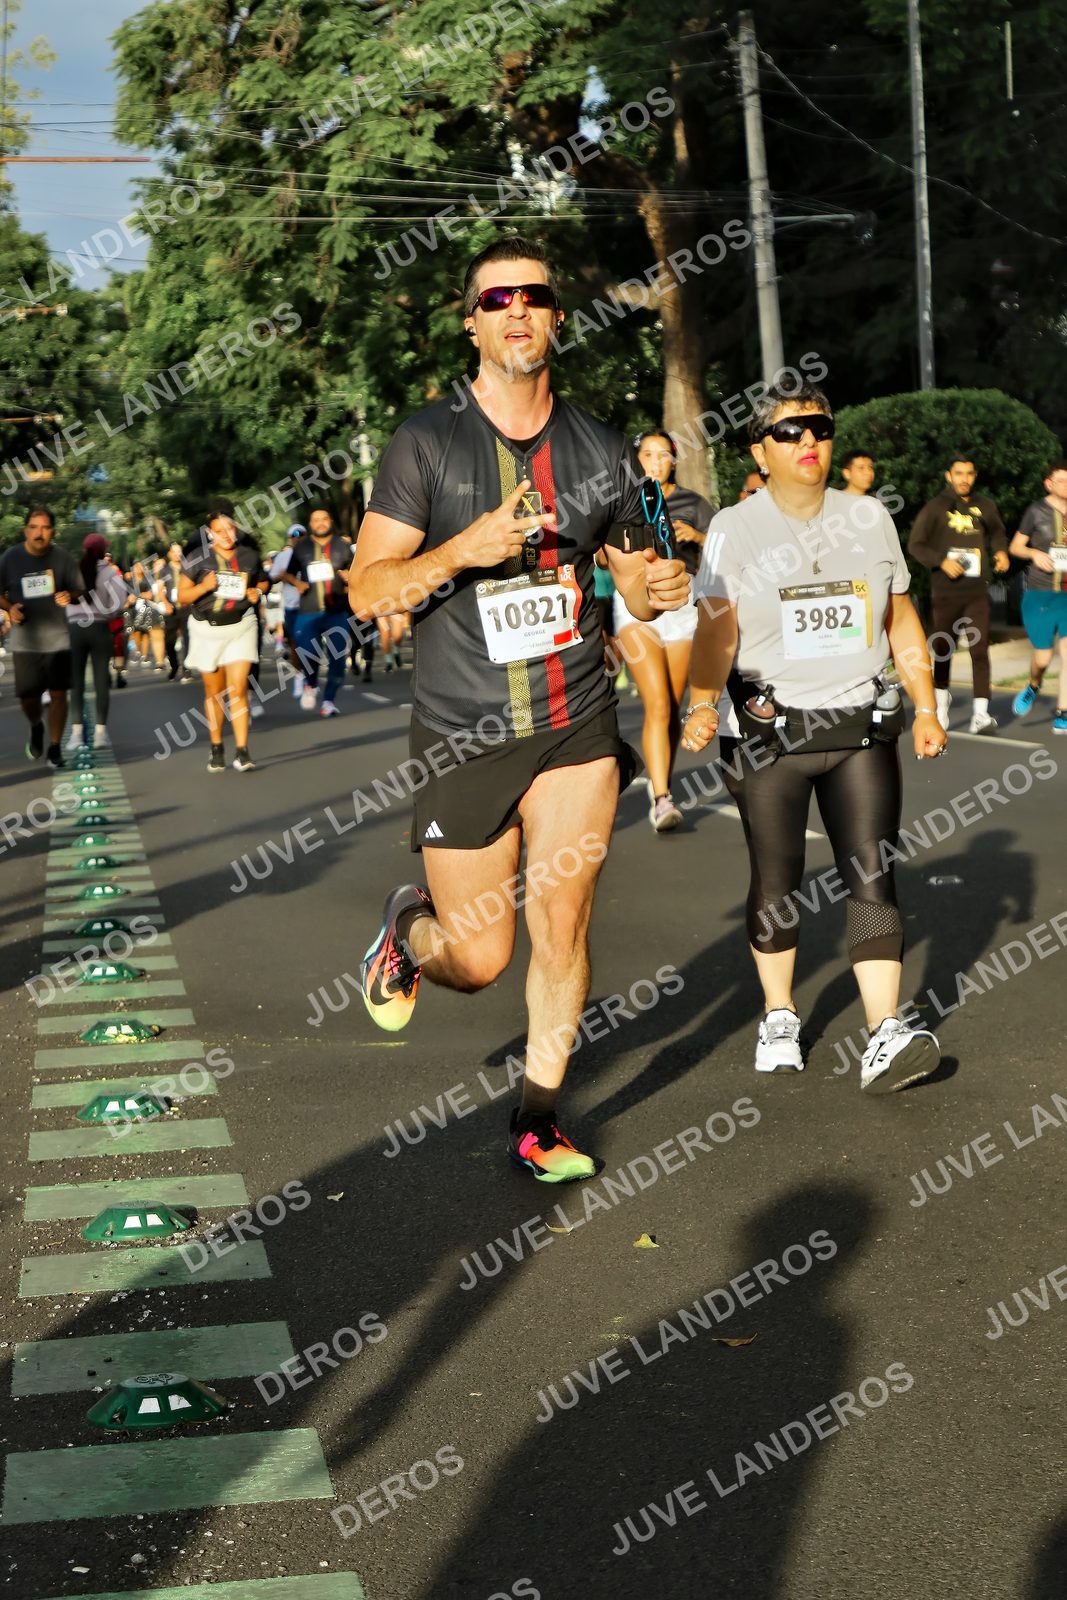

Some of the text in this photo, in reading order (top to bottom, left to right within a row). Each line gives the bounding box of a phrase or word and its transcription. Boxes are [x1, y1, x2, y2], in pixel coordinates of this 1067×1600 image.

[855, 585, 866, 593] 5K
[487, 593, 567, 632] 10821
[794, 605, 853, 633] 3982
